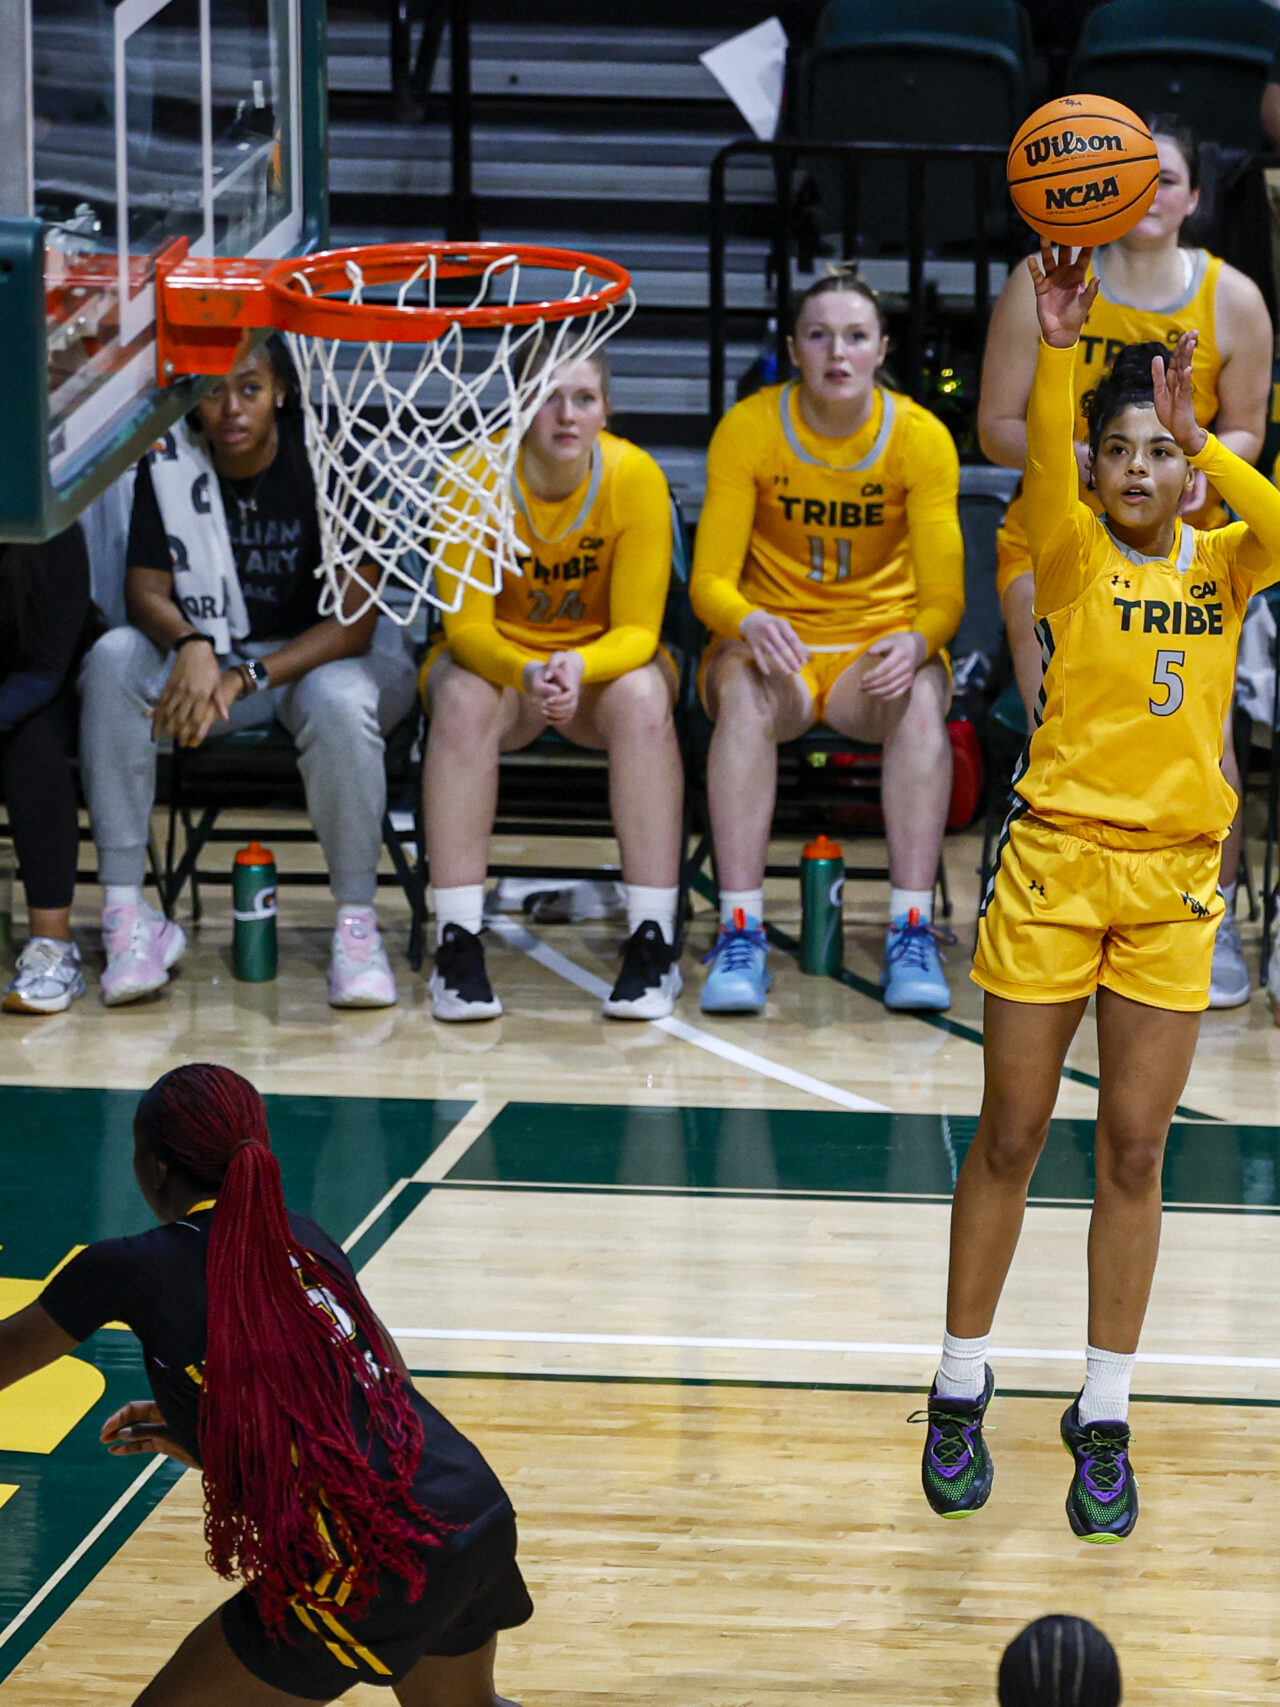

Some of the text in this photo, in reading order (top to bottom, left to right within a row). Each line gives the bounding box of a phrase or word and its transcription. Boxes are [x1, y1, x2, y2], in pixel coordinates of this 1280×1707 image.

[1024, 131, 1124, 167] Wilson
[1045, 175, 1120, 210] NCAA
[778, 494, 886, 528] TRIBE
[805, 534, 853, 582] 11
[1113, 597, 1224, 636] TRIBE
[1148, 649, 1186, 717] 5
